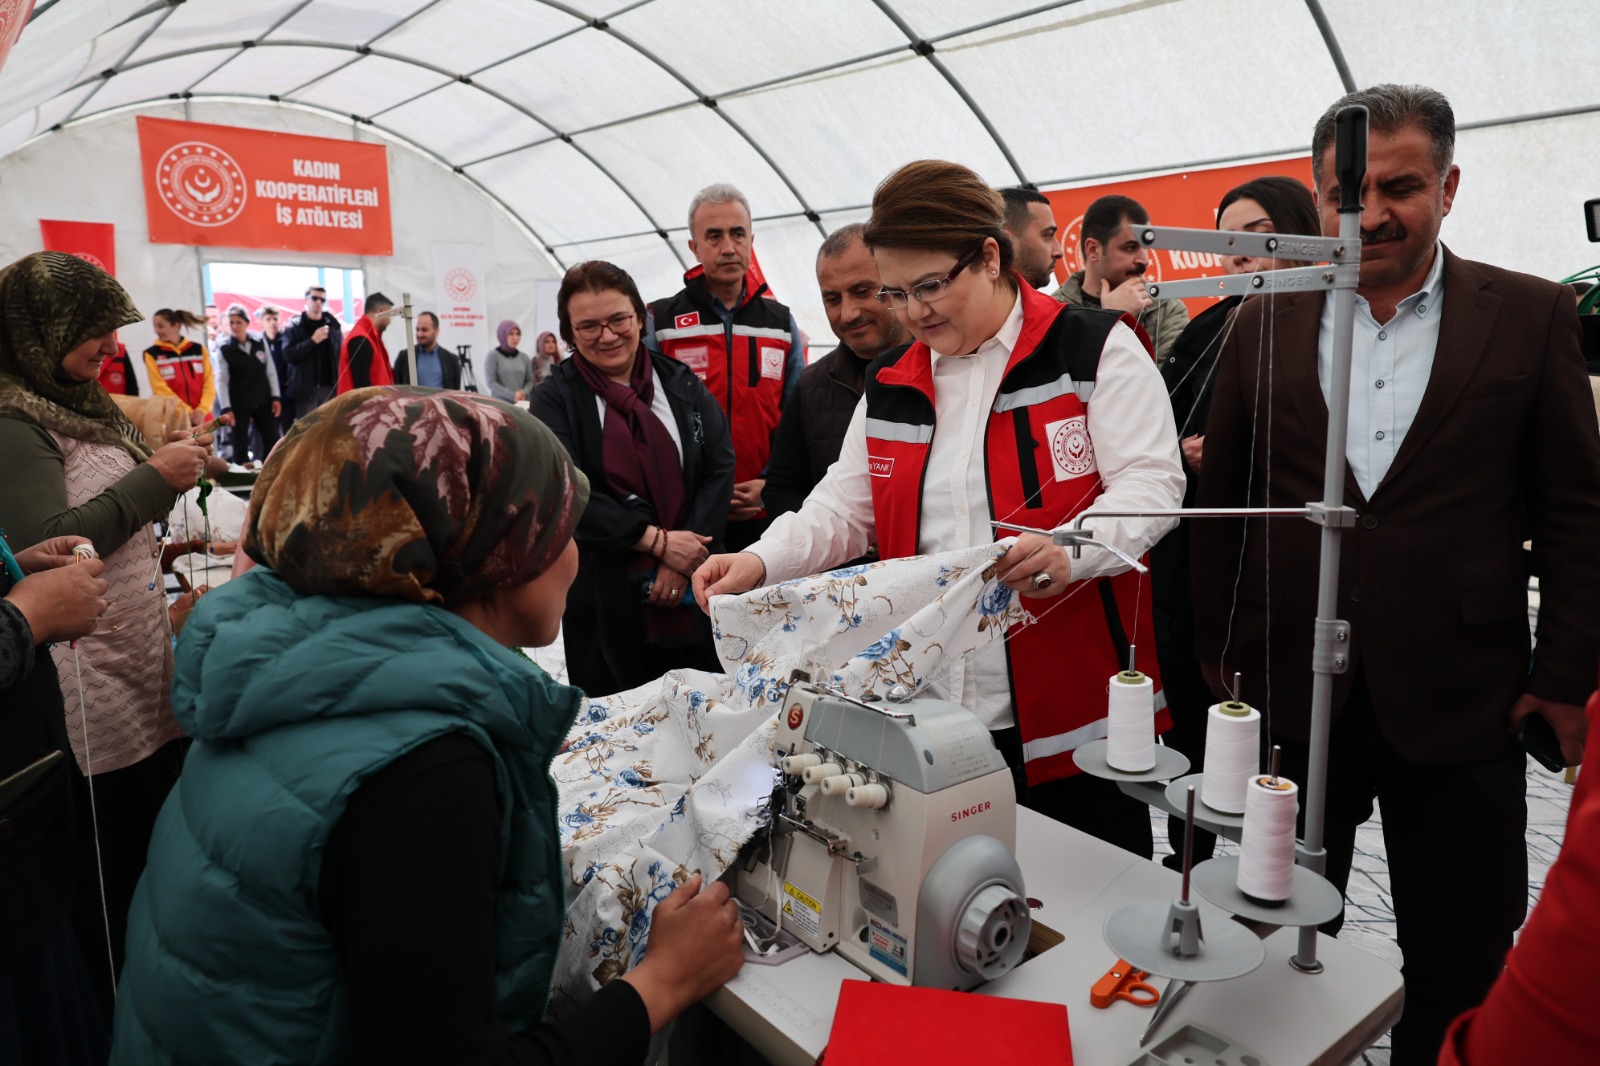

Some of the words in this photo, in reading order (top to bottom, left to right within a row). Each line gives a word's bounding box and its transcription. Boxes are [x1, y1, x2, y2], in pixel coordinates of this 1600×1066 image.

[293, 159, 341, 180] KADIN
[255, 179, 379, 207] KOOPERATİFLERİ
[276, 202, 293, 226] İŞ
[296, 206, 363, 229] ATÖLYESİ
[1278, 241, 1324, 256] SINGER
[1264, 274, 1313, 288] SINGER
[951, 801, 991, 822] SINGER
[796, 892, 817, 910] CAUTION
